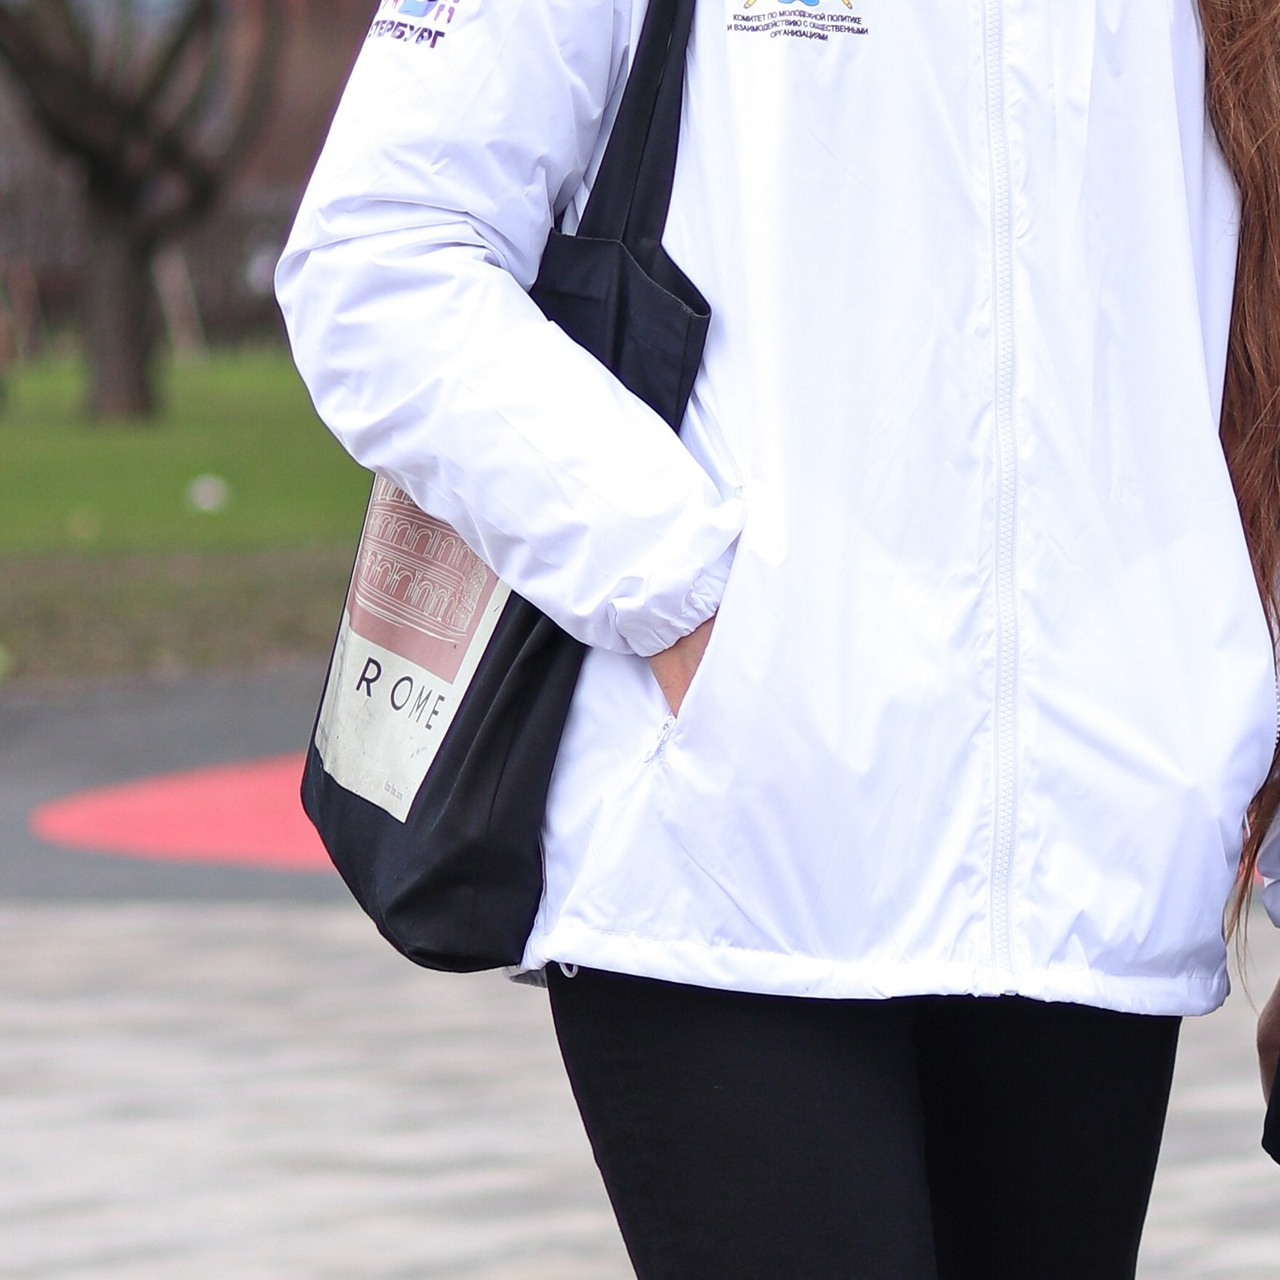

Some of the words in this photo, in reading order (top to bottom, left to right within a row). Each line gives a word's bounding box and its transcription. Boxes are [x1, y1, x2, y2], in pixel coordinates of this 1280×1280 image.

[733, 14, 766, 22] КОМИТЕТ
[767, 11, 778, 20] ПО
[827, 14, 862, 25] ПОЛИТИКЕ
[734, 19, 802, 32] ВЗАИМОДЕЙСТВИЮ
[809, 21, 869, 35] ОБЩЕСТВЕННЫМИ
[770, 29, 829, 42] ОРГАНИЗАЦИЯМИ
[356, 657, 446, 731] ROME
